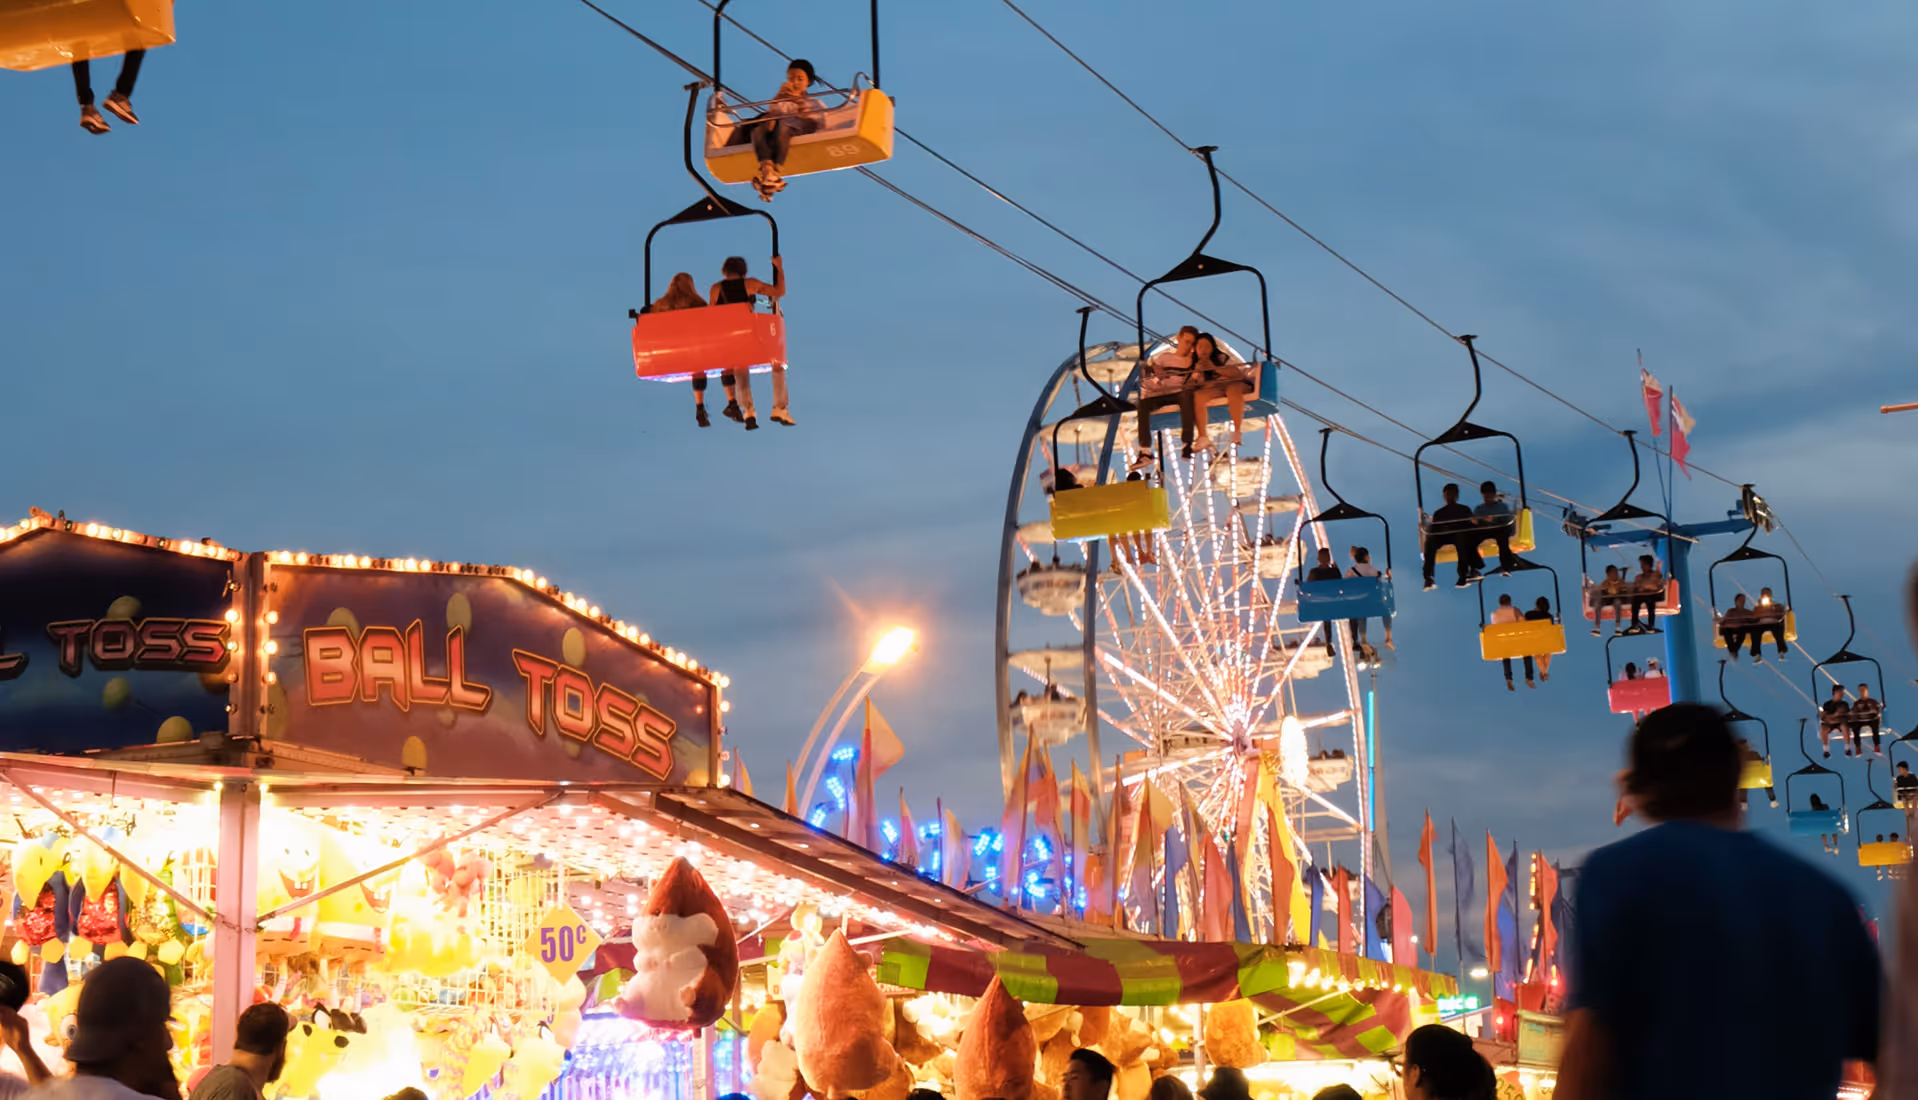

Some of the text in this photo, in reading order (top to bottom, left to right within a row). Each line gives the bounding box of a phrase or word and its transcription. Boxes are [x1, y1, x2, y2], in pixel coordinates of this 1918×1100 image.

[47, 617, 231, 677] TOSS
[303, 618, 677, 781] BALL TOSS
